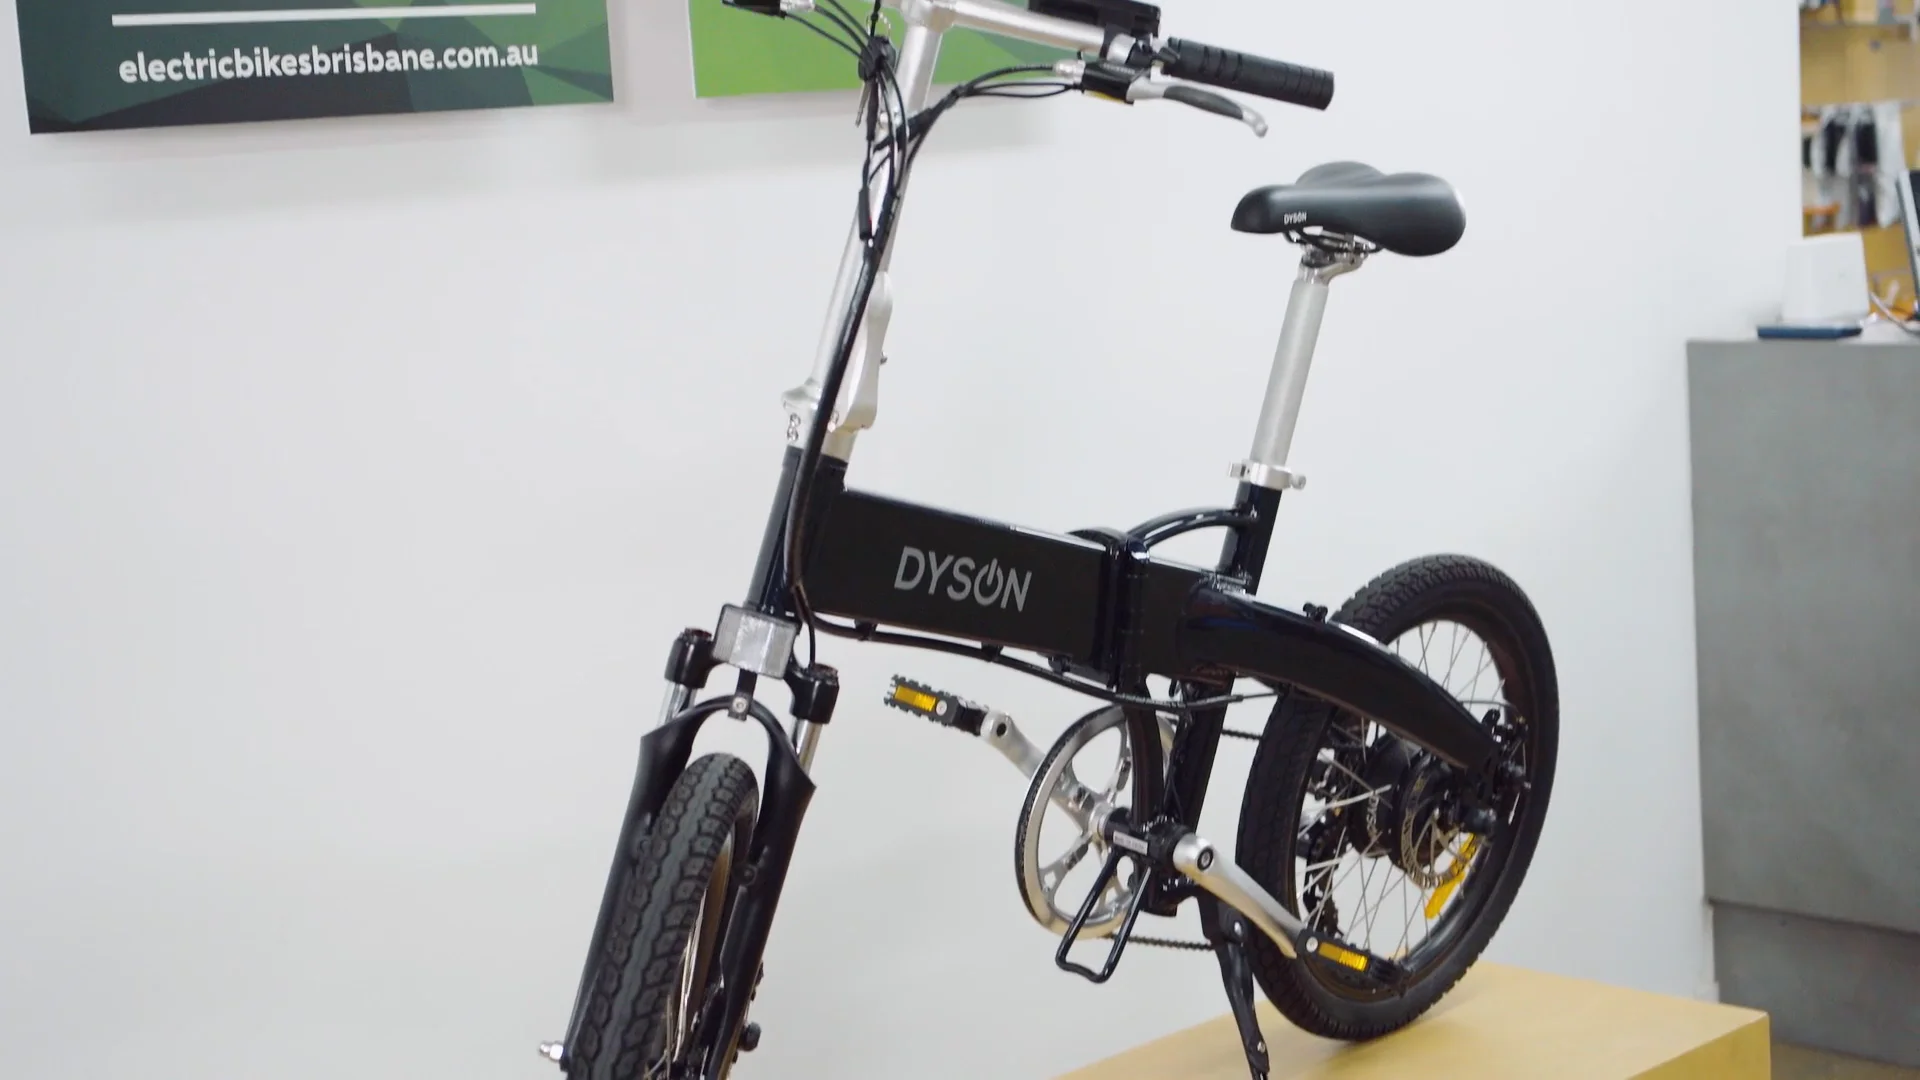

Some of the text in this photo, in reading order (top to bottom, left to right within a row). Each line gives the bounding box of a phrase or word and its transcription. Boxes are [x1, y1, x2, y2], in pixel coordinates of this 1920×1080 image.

[118, 43, 538, 83] electricbikesbrisbane.com.au
[1283, 211, 1307, 225] DYSON
[894, 545, 1032, 612] DYSON
